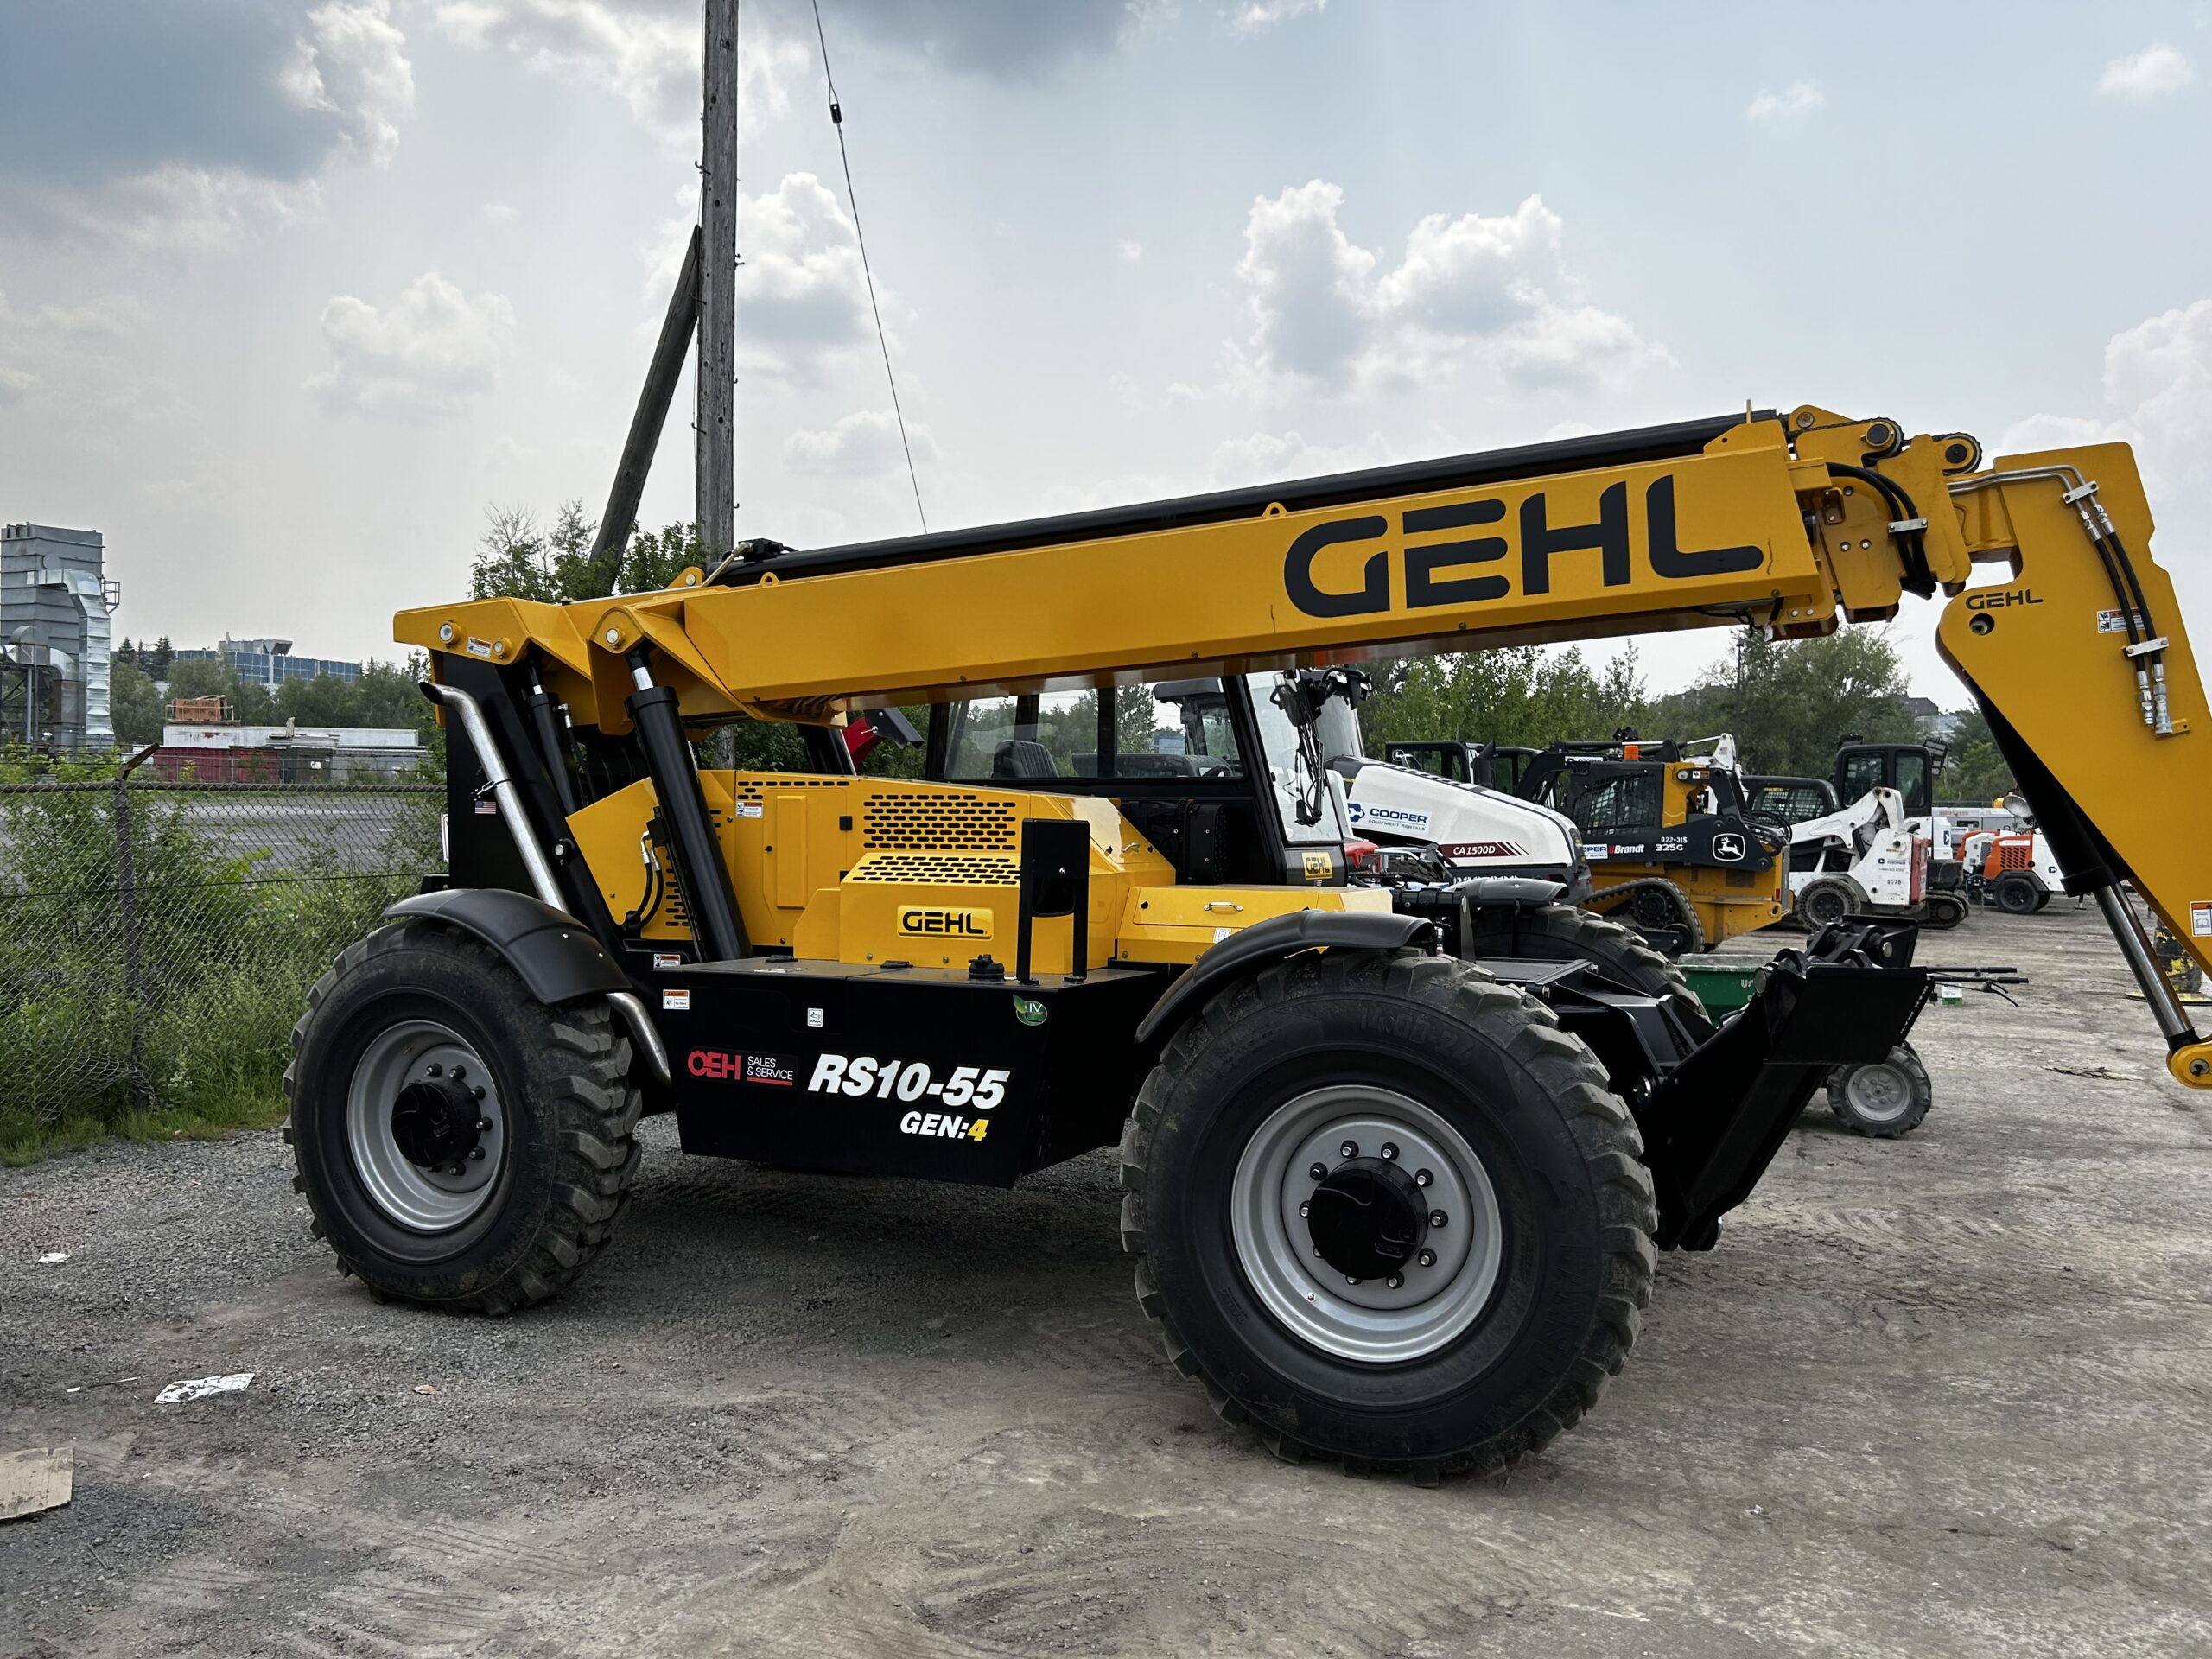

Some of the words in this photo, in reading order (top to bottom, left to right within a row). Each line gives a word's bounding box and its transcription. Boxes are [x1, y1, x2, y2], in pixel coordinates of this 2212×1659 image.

[1284, 474, 1764, 617] GEHL
[1966, 589, 2044, 610] GEHL
[1370, 808, 1427, 823] COOPER
[1452, 845, 1496, 855] CA1500D
[1614, 843, 1645, 854] Brandt
[1305, 856, 1331, 874] GEHL
[902, 911, 985, 935] GEHL
[688, 1050, 741, 1080] OEH
[747, 1056, 777, 1068] SALES
[747, 1066, 754, 1076] &
[755, 1067, 794, 1081] SERVICE
[807, 1053, 1010, 1109] RS10-55
[899, 1111, 989, 1141] GEN:4
